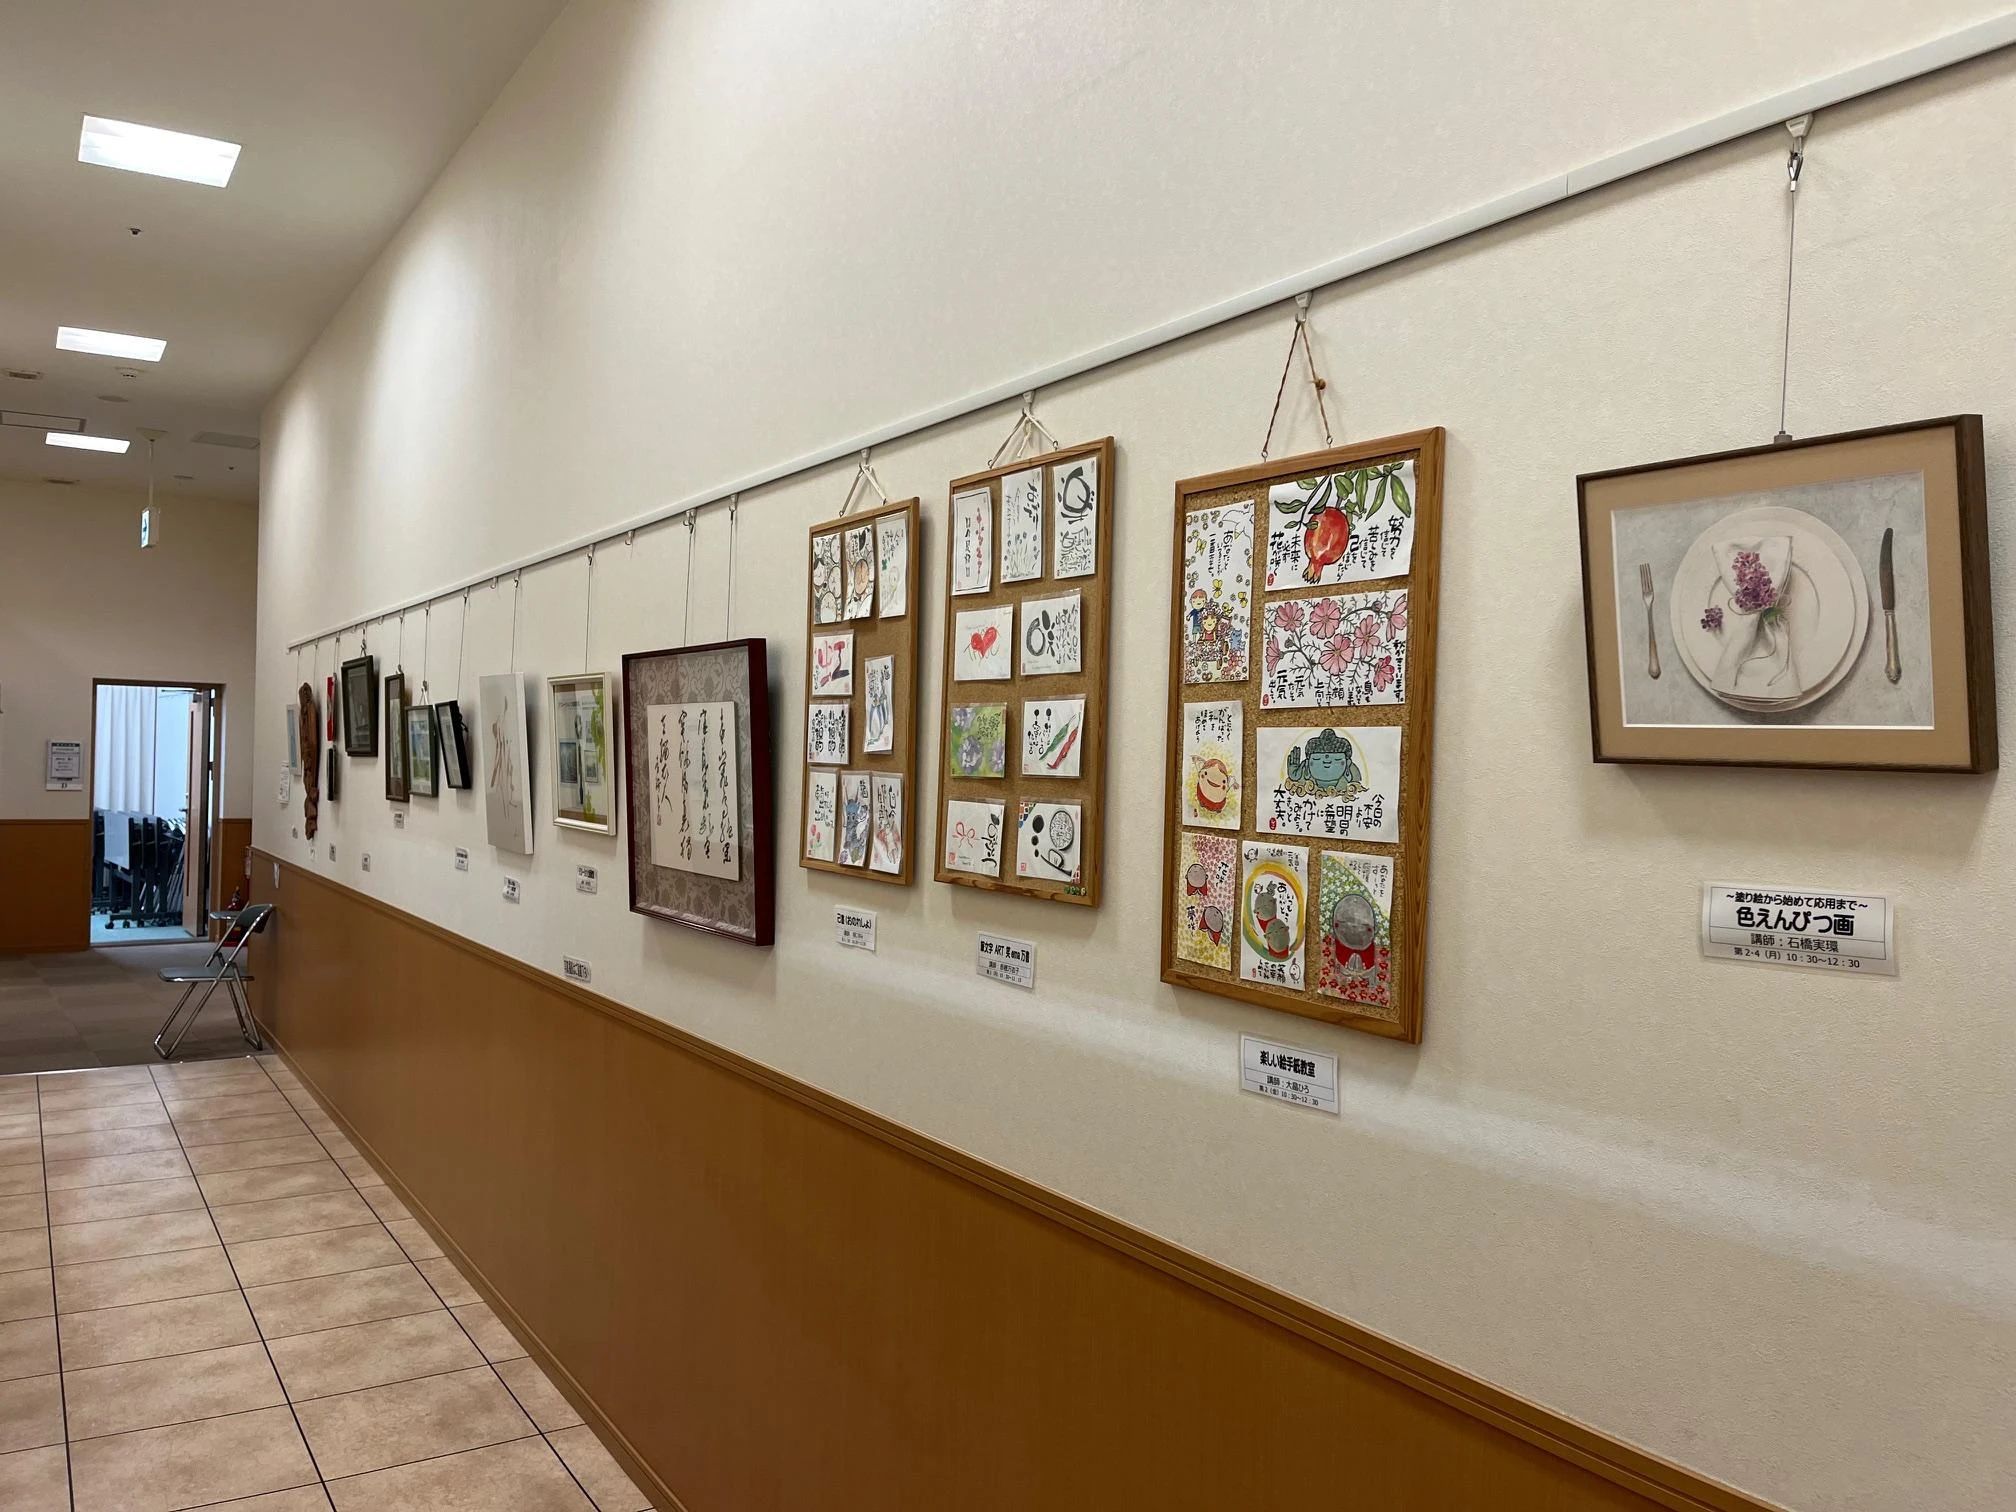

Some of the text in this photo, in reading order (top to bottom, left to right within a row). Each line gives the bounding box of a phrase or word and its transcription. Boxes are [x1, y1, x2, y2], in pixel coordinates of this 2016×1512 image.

[1270, 531, 1285, 576] 花が咲く
[1282, 540, 1290, 563] 必ず
[1290, 534, 1301, 571] 未来に
[1368, 525, 1379, 572] 苦しみを
[1388, 515, 1404, 560] 努力を
[1303, 799, 1316, 830] かけて
[1337, 806, 1353, 836] 明日の
[1372, 794, 1385, 827] 今日の
[1736, 906, 1855, 936] 色えんぴつ画
[1260, 1050, 1316, 1078] 楽しい絵手紙教室
